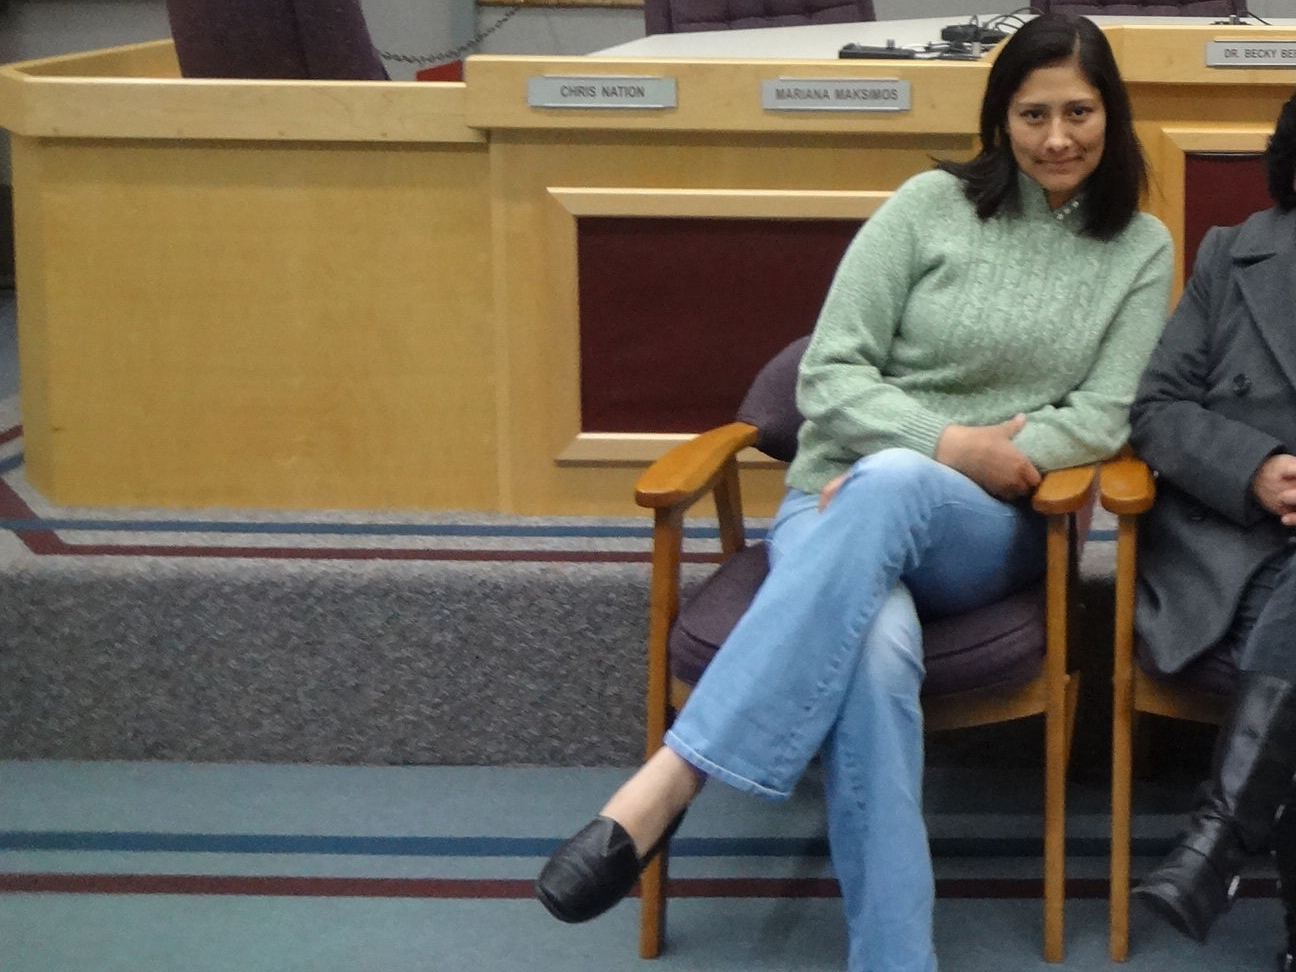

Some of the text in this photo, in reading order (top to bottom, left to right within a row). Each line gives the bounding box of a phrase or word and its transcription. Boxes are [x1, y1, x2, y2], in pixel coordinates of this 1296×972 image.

[1223, 48, 1240, 59] DR.
[1244, 48, 1277, 59] BECKY
[559, 84, 646, 99] CHRIS NATION
[774, 88, 900, 101] MARIANA MAKSIMOS
